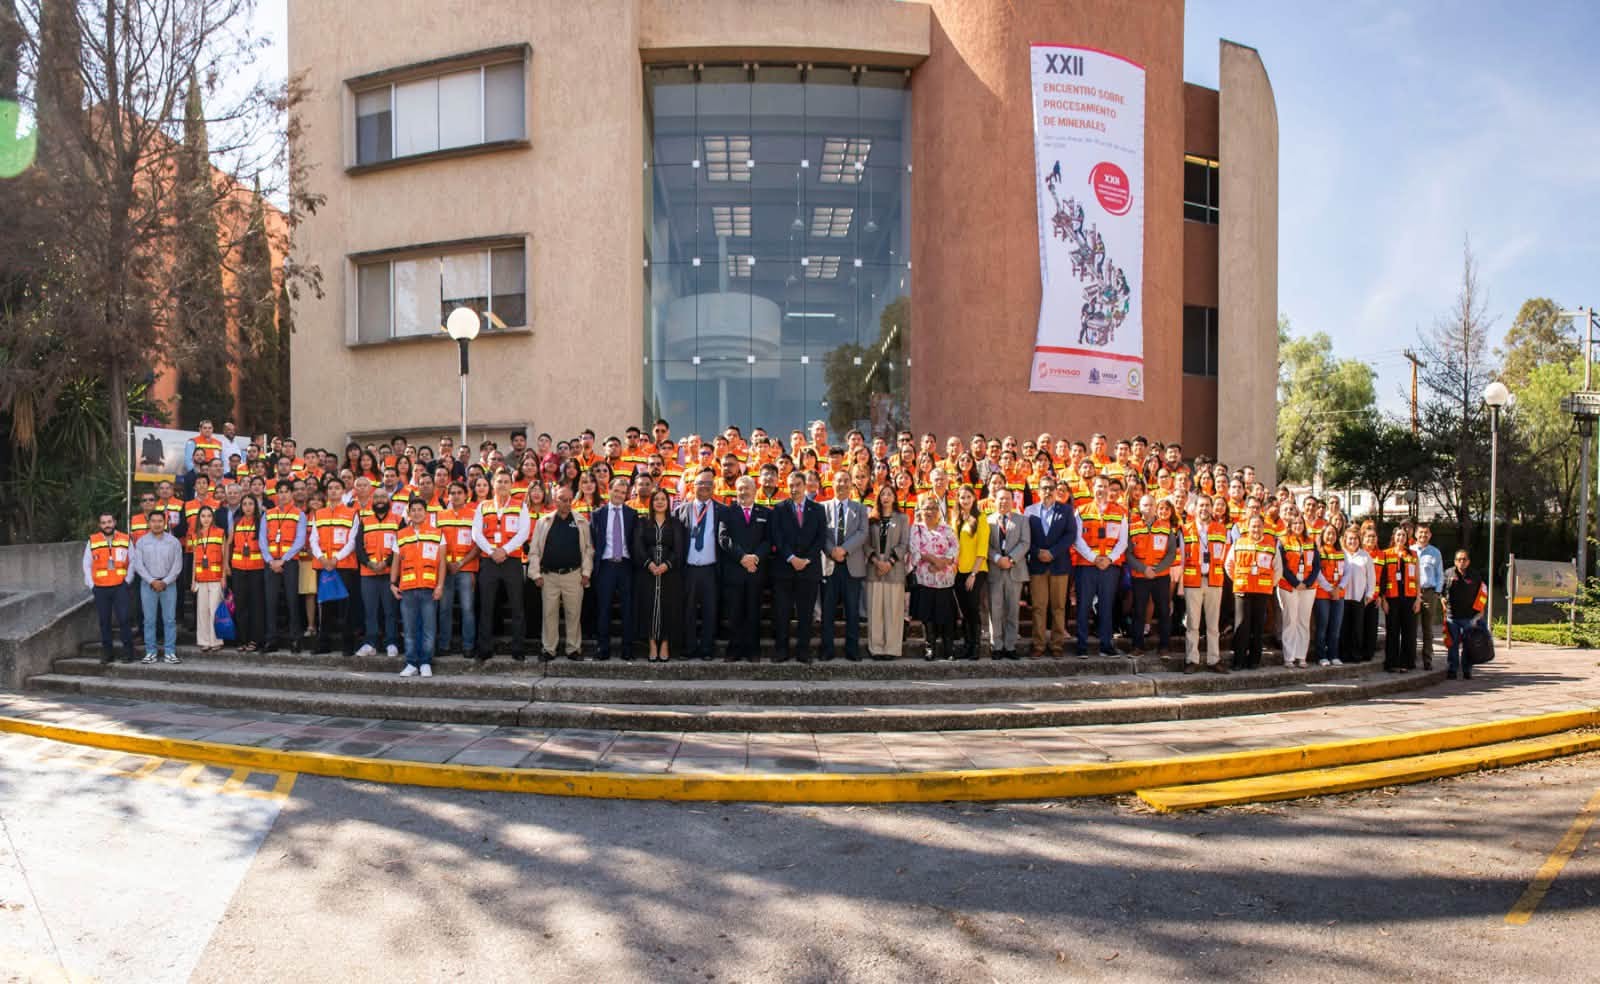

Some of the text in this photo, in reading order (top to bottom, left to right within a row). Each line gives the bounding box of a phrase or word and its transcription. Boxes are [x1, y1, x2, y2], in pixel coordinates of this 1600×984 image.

[1046, 54, 1083, 76] XXII
[1043, 83, 1125, 104] ENCUENTRO SOBRE
[1043, 100, 1117, 119] PROCESAMIENTO
[1043, 116, 1105, 133] DE MINERALES
